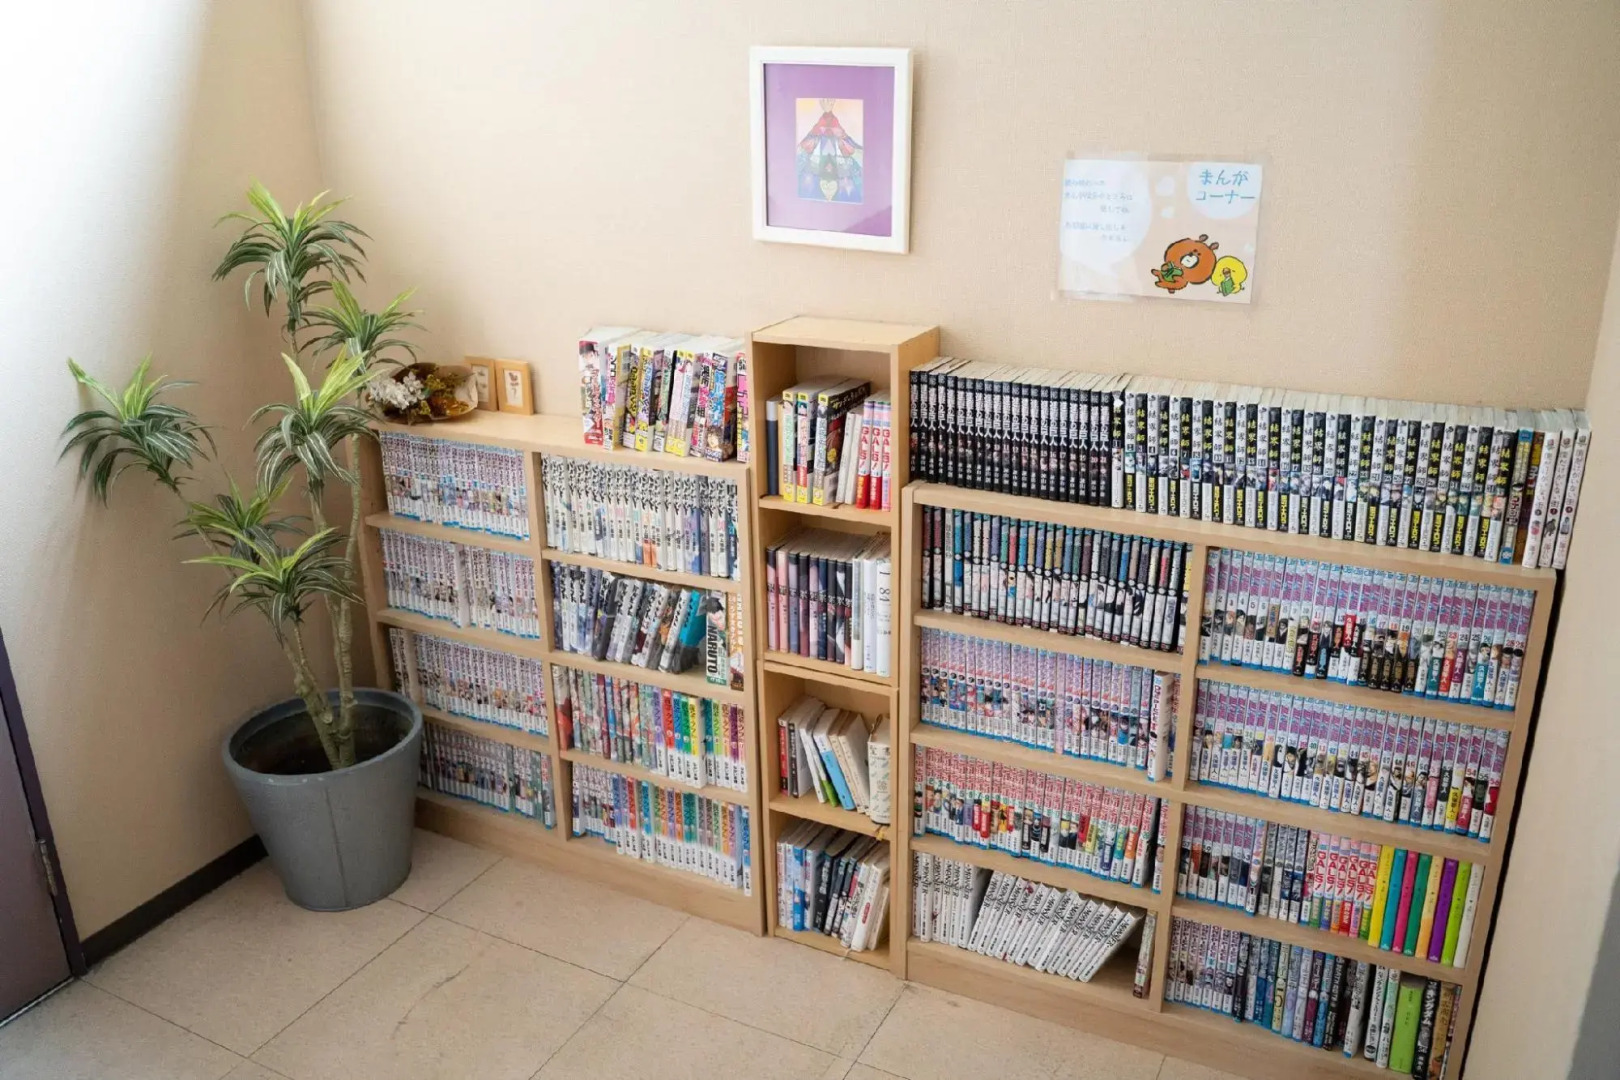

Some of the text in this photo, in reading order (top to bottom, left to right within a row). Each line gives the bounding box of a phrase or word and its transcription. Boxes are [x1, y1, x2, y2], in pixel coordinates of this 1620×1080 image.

[1196, 190, 1256, 204] コーナー
[1198, 170, 1248, 186] まんが
[859, 427, 869, 468] GALS!
[871, 427, 880, 469] GALS!
[708, 626, 718, 673] NARUTO
[1315, 852, 1326, 890] GALS!
[1327, 853, 1338, 891] GALS!
[1337, 856, 1348, 896] GALS!
[1347, 855, 1358, 893] GALS!
[1357, 860, 1368, 899] GALS!
[1365, 862, 1377, 901] GALS!
